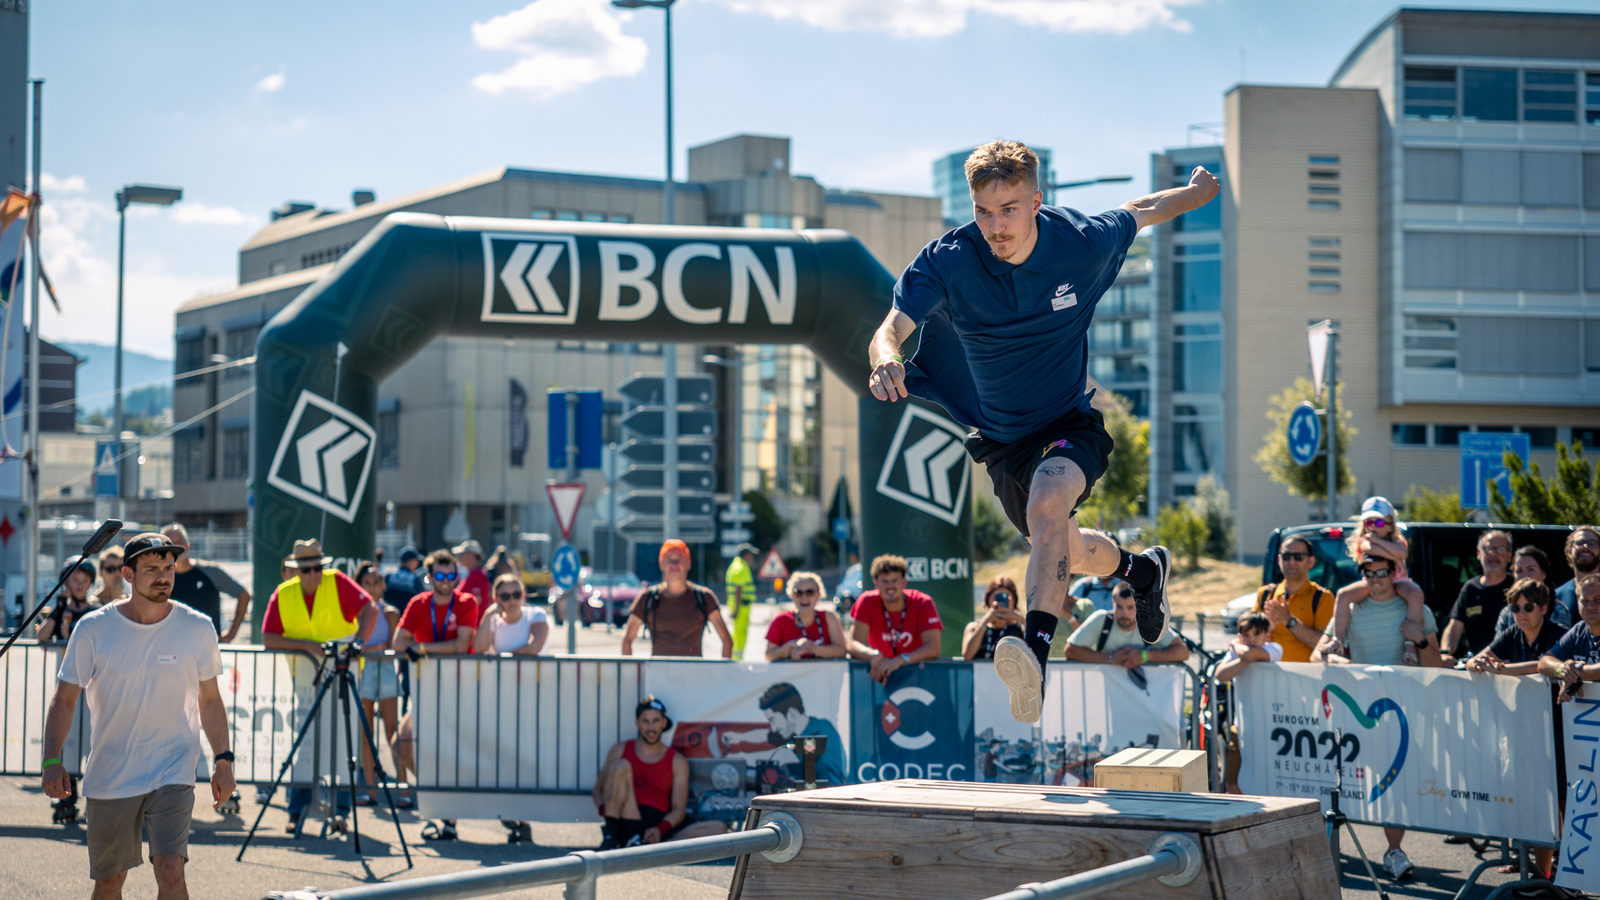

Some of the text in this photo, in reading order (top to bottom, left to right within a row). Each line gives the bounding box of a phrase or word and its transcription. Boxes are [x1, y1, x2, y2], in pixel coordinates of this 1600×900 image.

[598, 241, 797, 325] BCN
[323, 558, 362, 580] CN
[930, 557, 969, 580] BCN
[1273, 714, 1319, 725] EUROGYM
[1271, 727, 1360, 763] 2022
[858, 762, 965, 782] CODEC
[1301, 784, 1315, 793] JULY
[1320, 786, 1364, 799] SWRLAND
[1451, 789, 1470, 799] GYM
[1472, 791, 1490, 802] TIME
[1562, 697, 1600, 875] KÄSLIN
